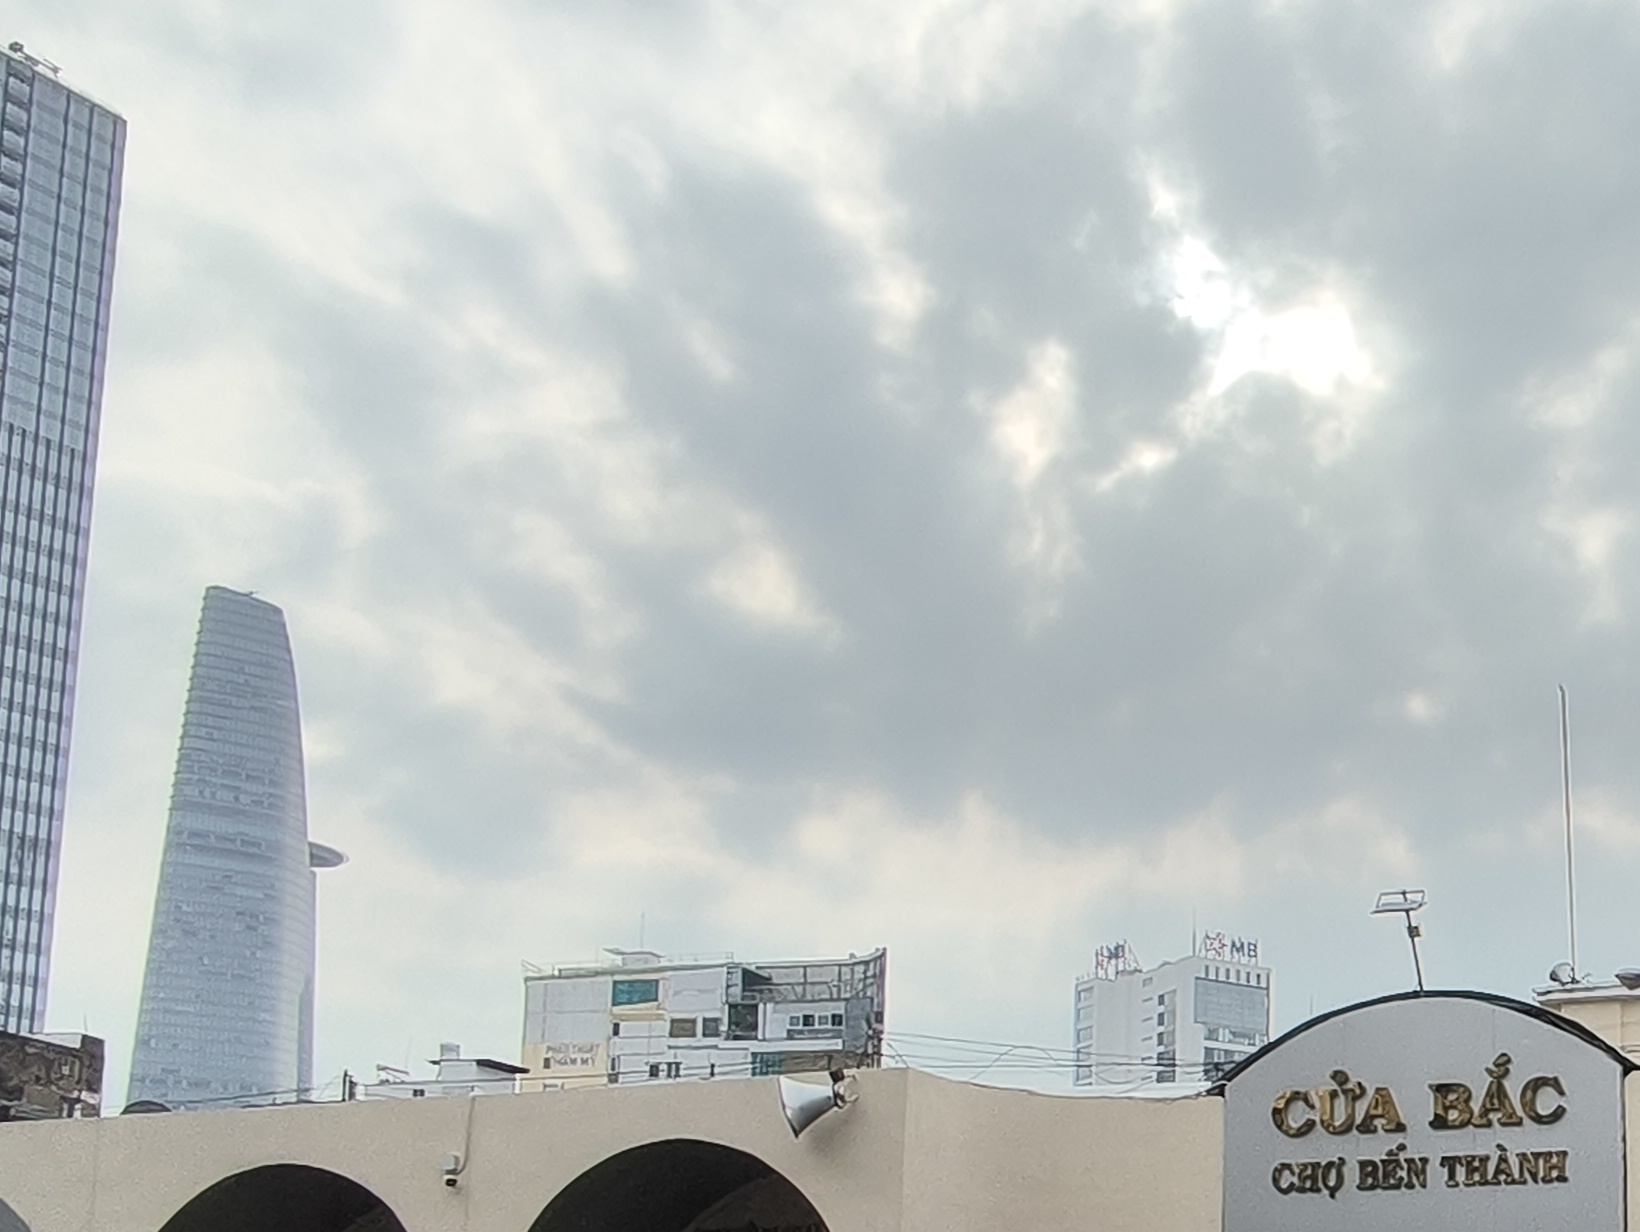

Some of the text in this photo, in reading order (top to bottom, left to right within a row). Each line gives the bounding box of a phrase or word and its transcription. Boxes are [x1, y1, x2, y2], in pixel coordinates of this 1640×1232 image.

[1271, 1052, 1567, 1138] CỬA BẮC
[1272, 1142, 1568, 1199] CHỢ BẾN THÀNH
